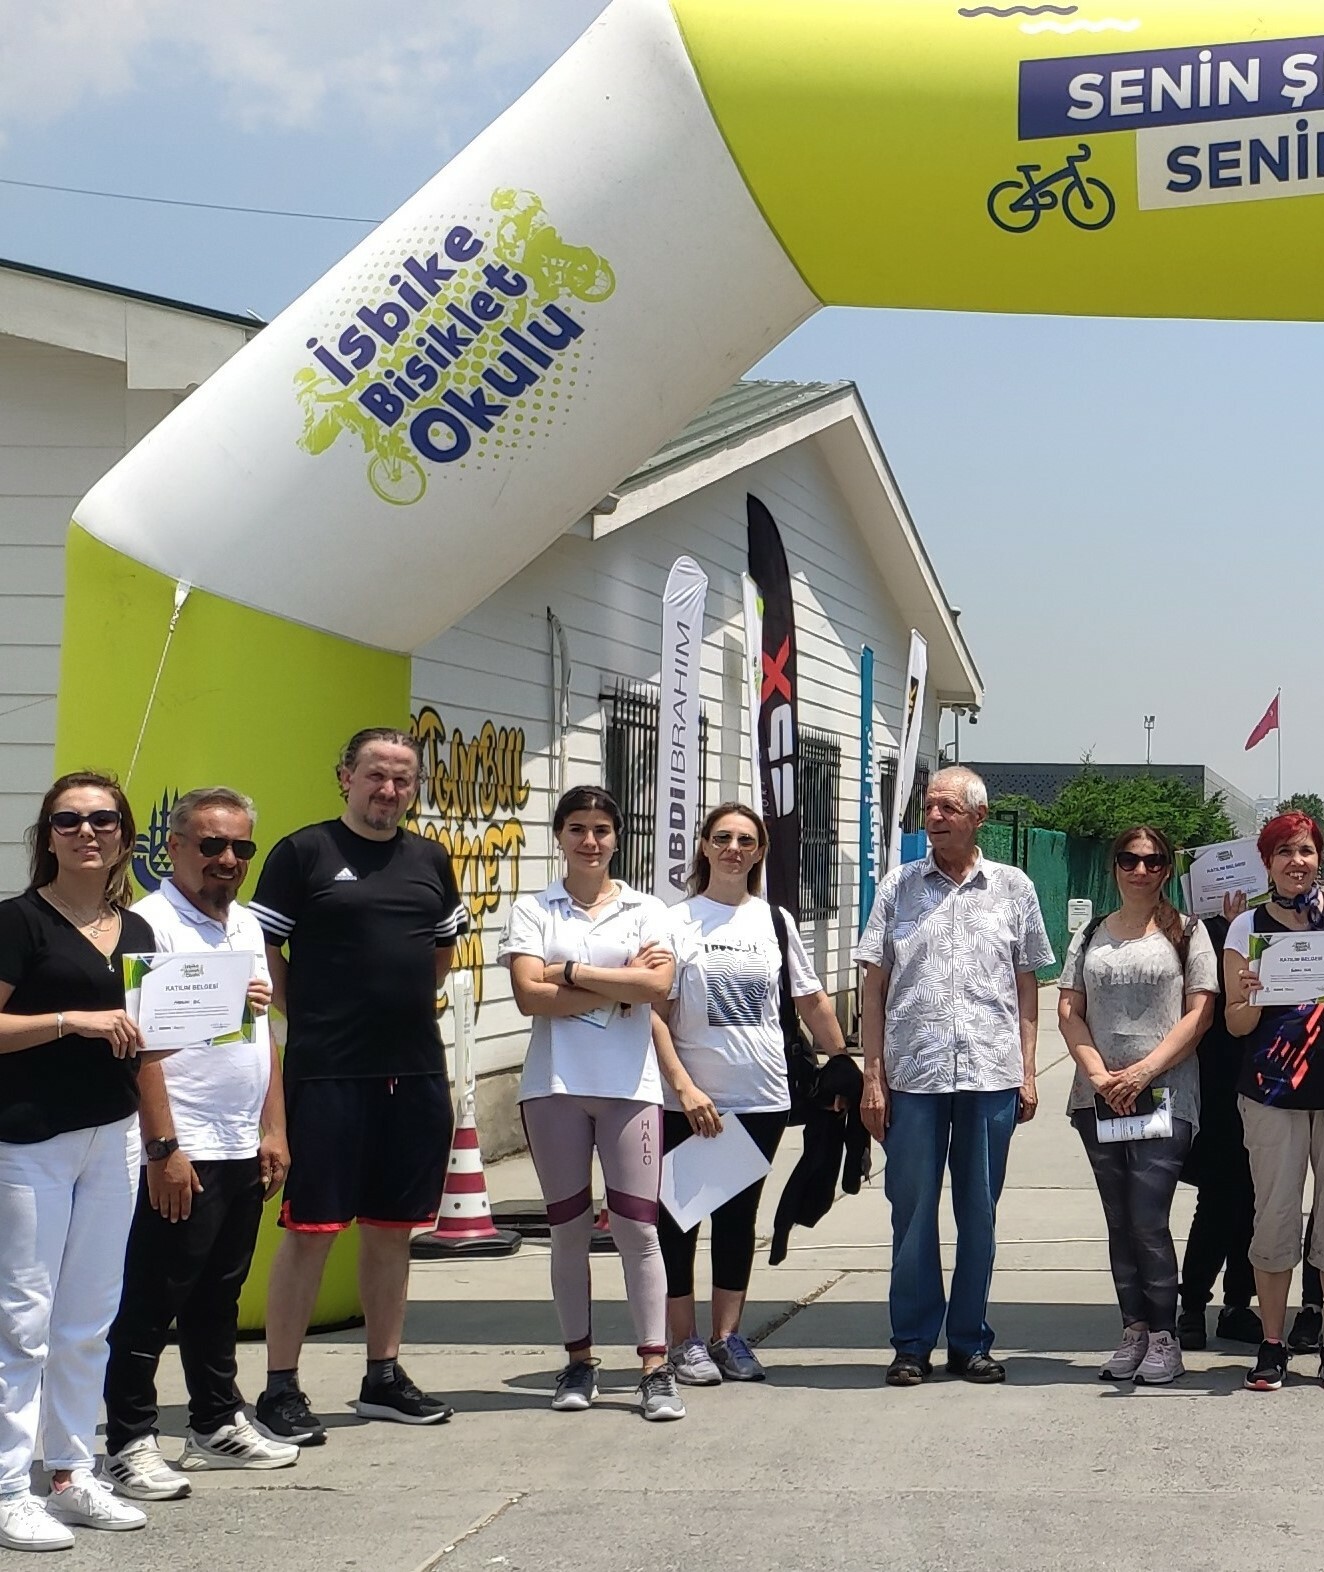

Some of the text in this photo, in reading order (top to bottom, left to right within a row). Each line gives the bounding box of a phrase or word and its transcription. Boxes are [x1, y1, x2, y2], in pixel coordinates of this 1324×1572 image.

[1066, 50, 1261, 121] SENİN
[358, 262, 529, 428] Bisiklet
[409, 303, 586, 465] Okulu
[641, 1119, 652, 1166] HALO
